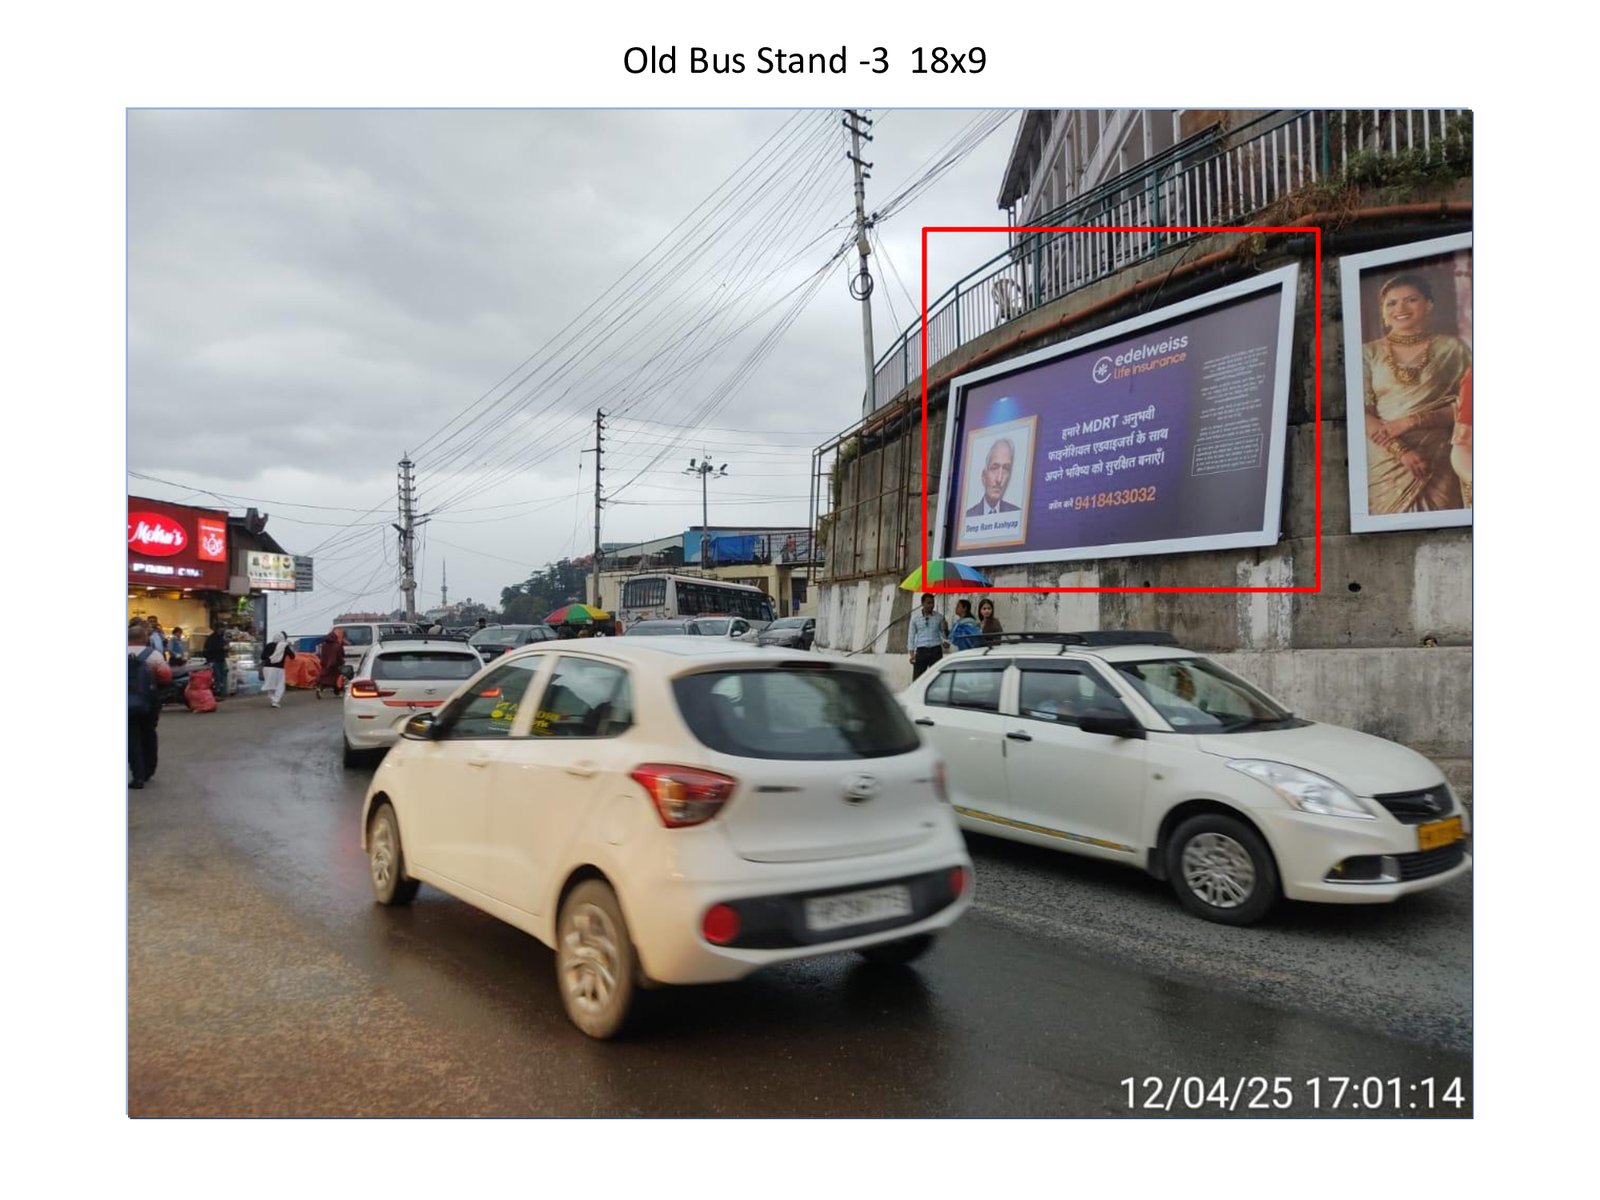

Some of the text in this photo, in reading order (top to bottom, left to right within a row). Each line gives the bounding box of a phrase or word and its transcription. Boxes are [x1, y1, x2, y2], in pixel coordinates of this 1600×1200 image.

[1115, 336, 1189, 366] edelweiss
[1114, 352, 1187, 379] life insurance
[1061, 404, 1156, 440] हमारे MDRT अनुभवी
[1136, 429, 1147, 445] के
[1149, 428, 1169, 443] साथ
[1045, 466, 1064, 482] अपने
[1065, 462, 1090, 478] भविष्य
[1091, 458, 1104, 474] को
[1105, 454, 1136, 476] सुरक्षित
[1075, 485, 1157, 510] 9418433032
